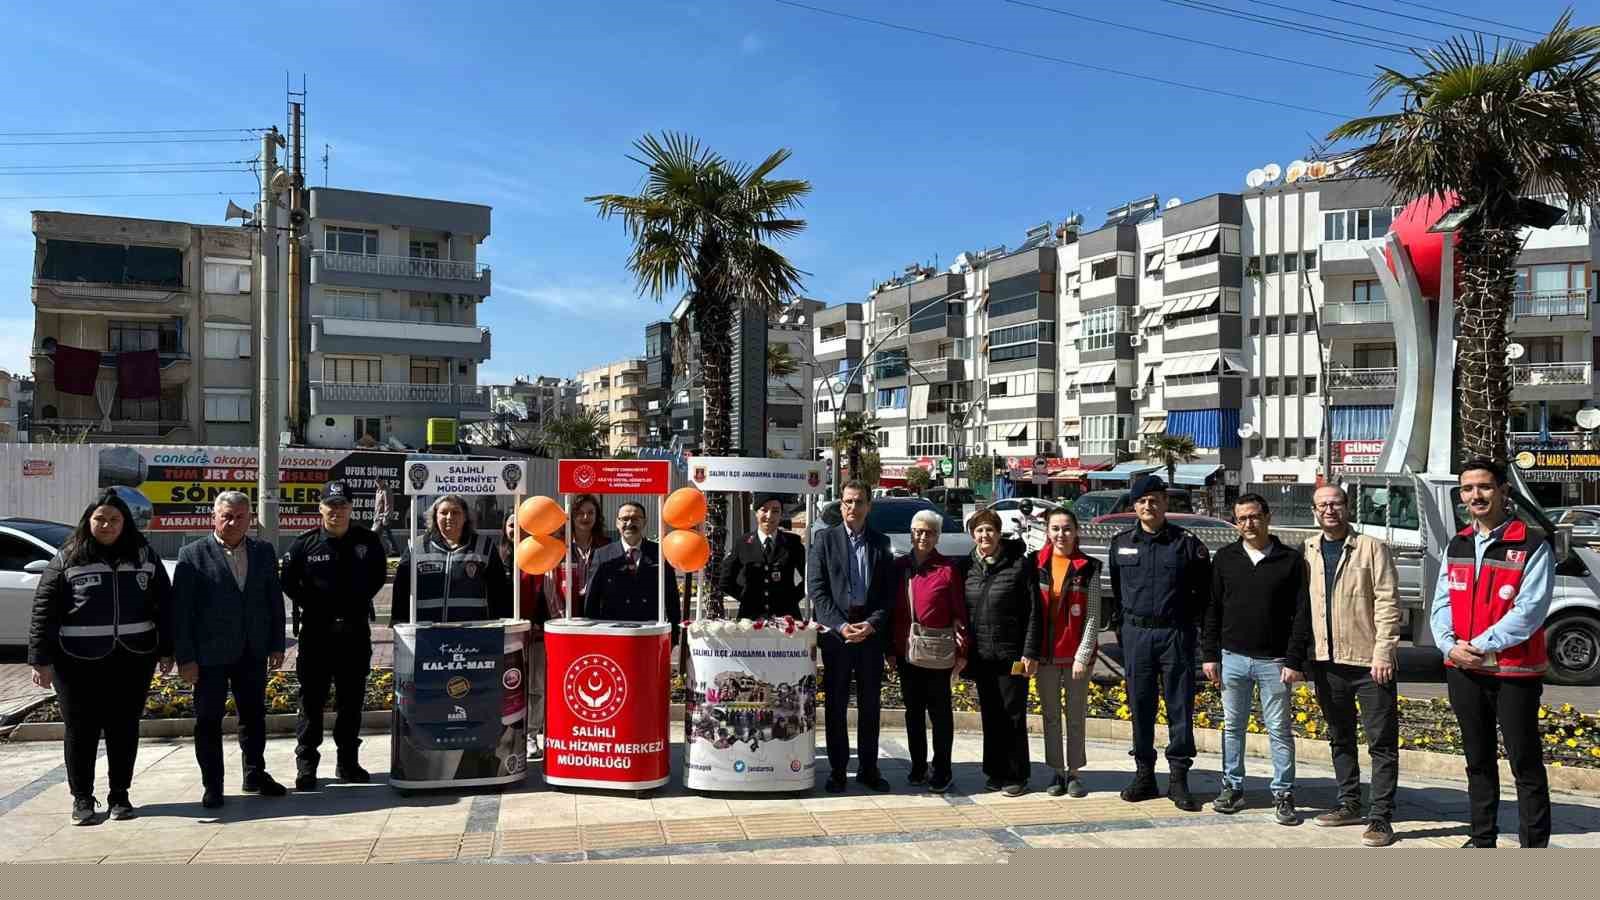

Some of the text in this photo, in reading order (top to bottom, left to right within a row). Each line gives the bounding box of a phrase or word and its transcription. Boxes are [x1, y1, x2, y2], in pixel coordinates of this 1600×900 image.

[213, 455, 258, 467] akarya
[1536, 452, 1600, 469] ÖZ MARAŞ DONDURM
[204, 469, 228, 480] JET
[448, 466, 485, 474] SALİHLİ
[457, 475, 498, 483] EMNİYET
[437, 484, 496, 493] MÜDÜRLÜĞÜ
[160, 517, 213, 527] TARAFIN
[452, 653, 466, 662] EL
[729, 649, 766, 658] JANDARMA
[572, 725, 616, 738] SALİHLİ
[546, 737, 664, 754] SYAL HİZMET MERKEZİ
[557, 754, 631, 769] MÜDÜRLÜĞÜ
